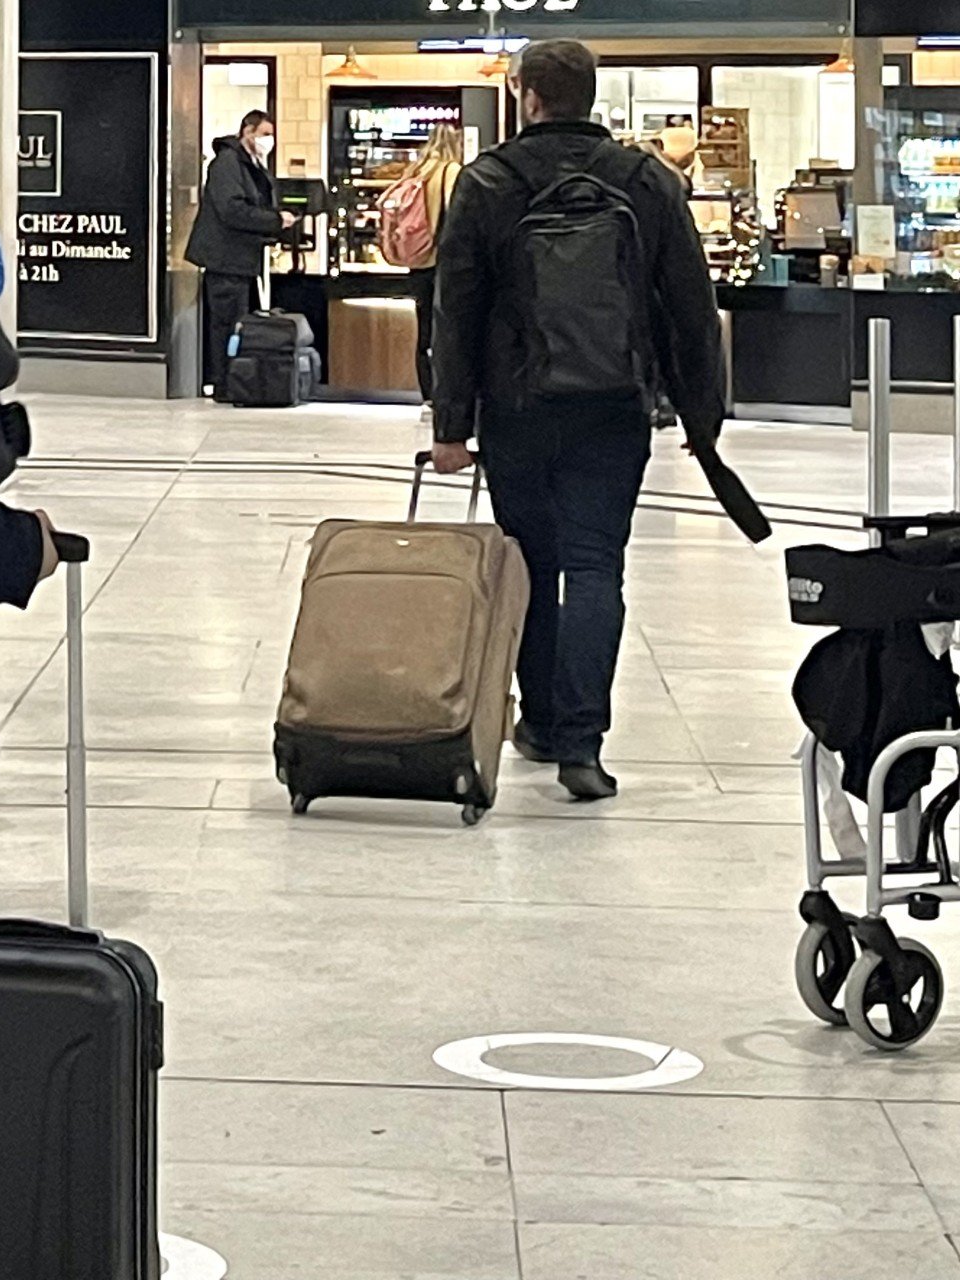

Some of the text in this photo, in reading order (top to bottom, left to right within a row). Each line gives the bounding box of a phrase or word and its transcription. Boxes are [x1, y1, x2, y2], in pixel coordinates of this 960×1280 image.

[19, 214, 127, 234] CHEZ PAUL
[29, 244, 48, 257] au
[52, 240, 131, 259] Dimanche
[31, 264, 60, 282] 21h
